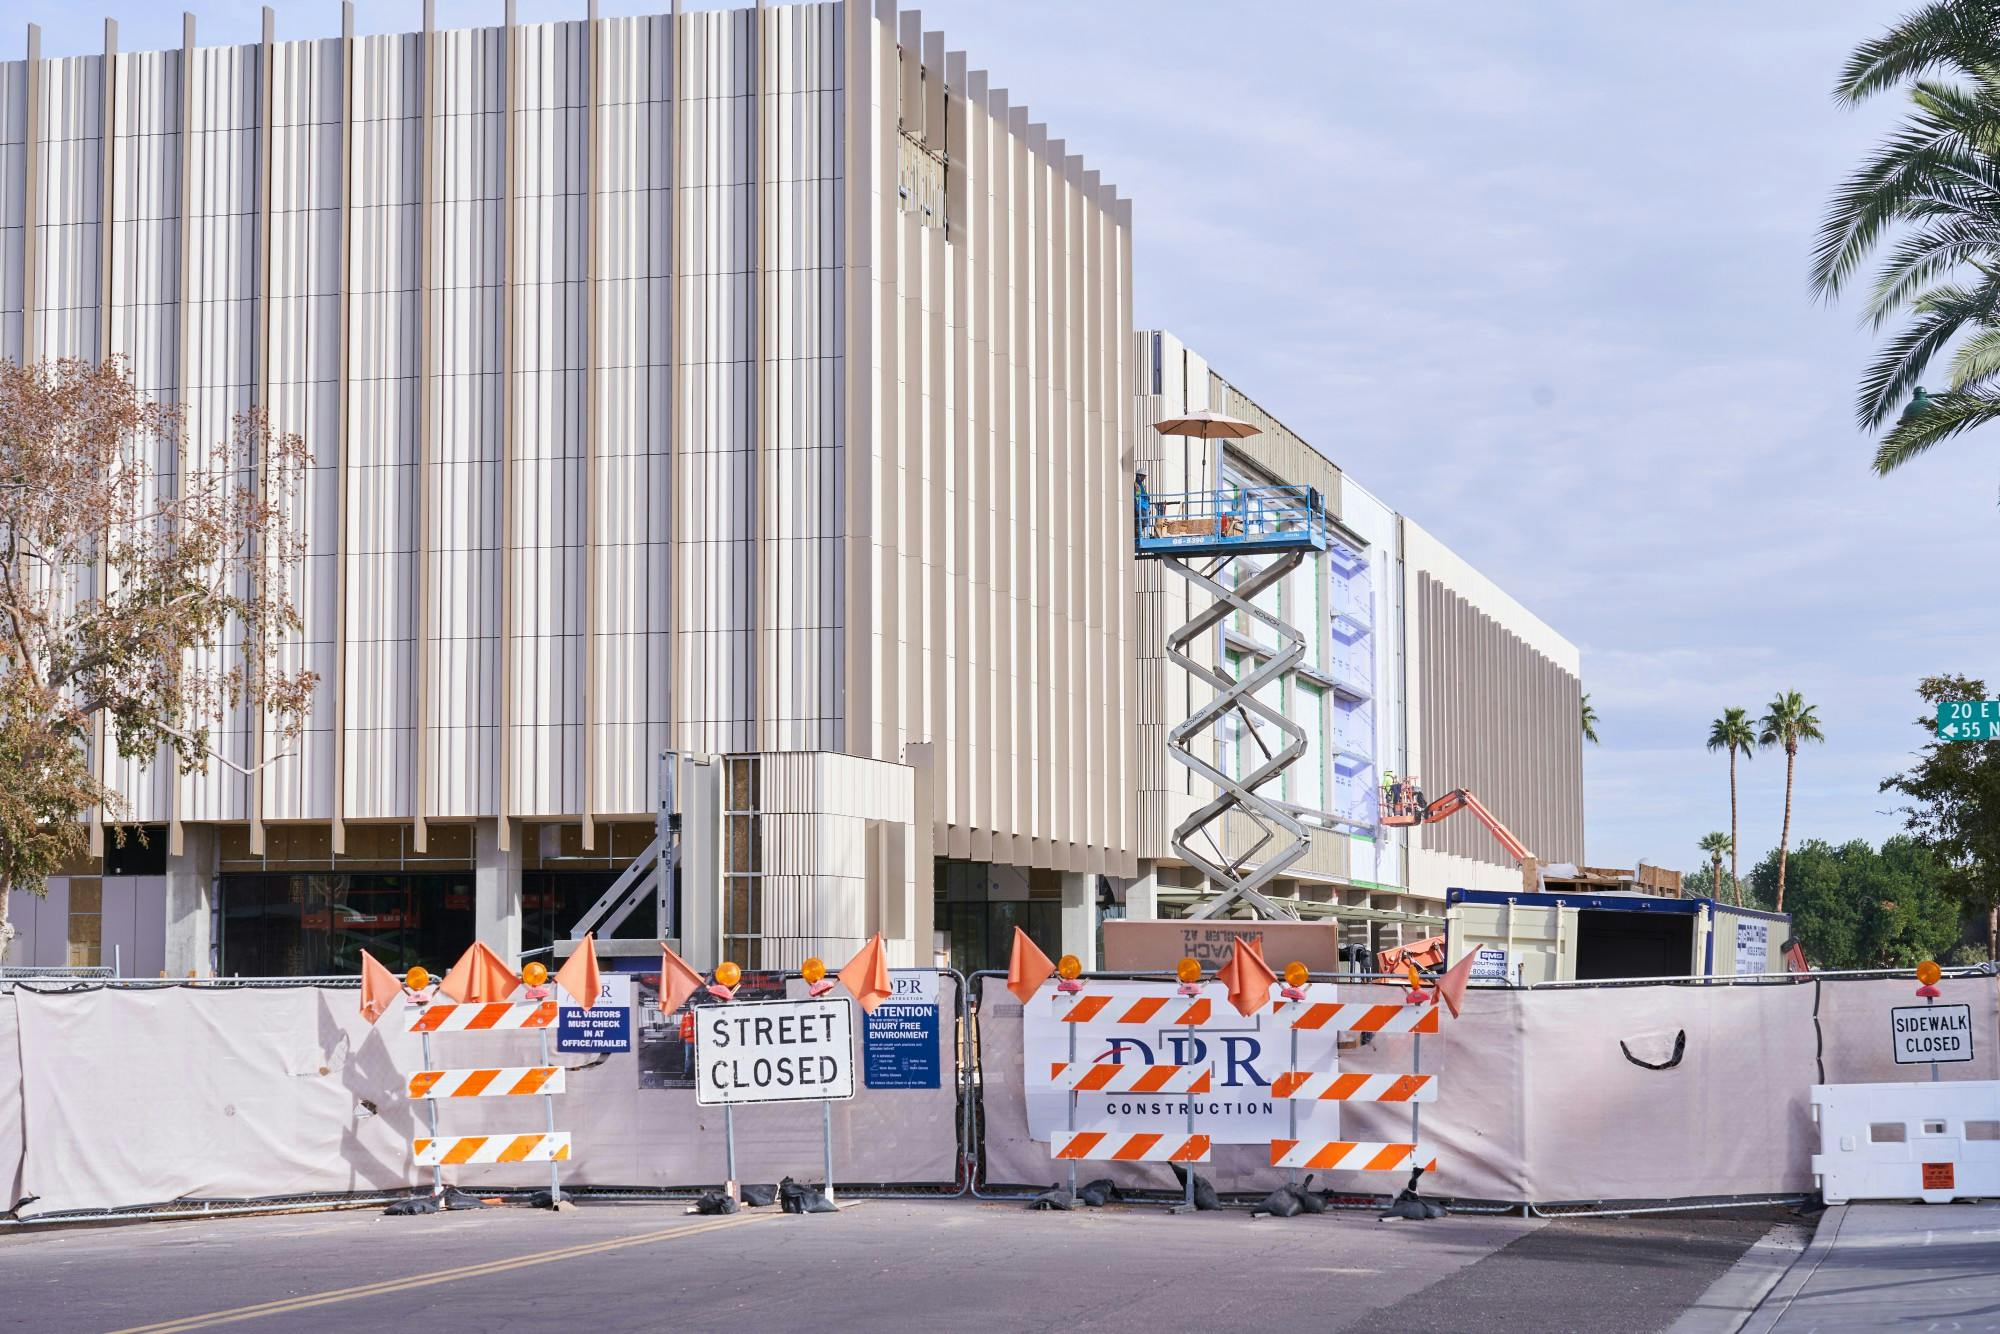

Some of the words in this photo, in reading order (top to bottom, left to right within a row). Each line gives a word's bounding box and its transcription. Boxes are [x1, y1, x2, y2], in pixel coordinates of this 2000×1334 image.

[1254, 609, 1280, 626] KOVACH
[1951, 703, 1972, 719] 20
[1981, 702, 1990, 718] E
[1182, 710, 1207, 729] KOVACH
[1962, 721, 1981, 738] 55
[1184, 943, 1233, 958] VACH
[567, 1010, 581, 1018] ALL
[583, 1010, 621, 1018] VISITORS
[869, 1006, 932, 1017] ATTENTION
[568, 1020, 590, 1028] MUST
[592, 1020, 620, 1028] CHECK
[712, 1013, 837, 1048] STREET
[869, 1022, 898, 1030] INJURY
[900, 1022, 921, 1030] FREE
[1896, 1016, 1967, 1032] SIDEWALK
[869, 1031, 929, 1039] ENVIRONMENT
[562, 1039, 627, 1047] OFFICE/TRAILER
[1906, 1037, 1960, 1052] CLOSED
[711, 1055, 838, 1089] CLOSED
[1106, 1103, 1273, 1114] CONSTRUCTION
